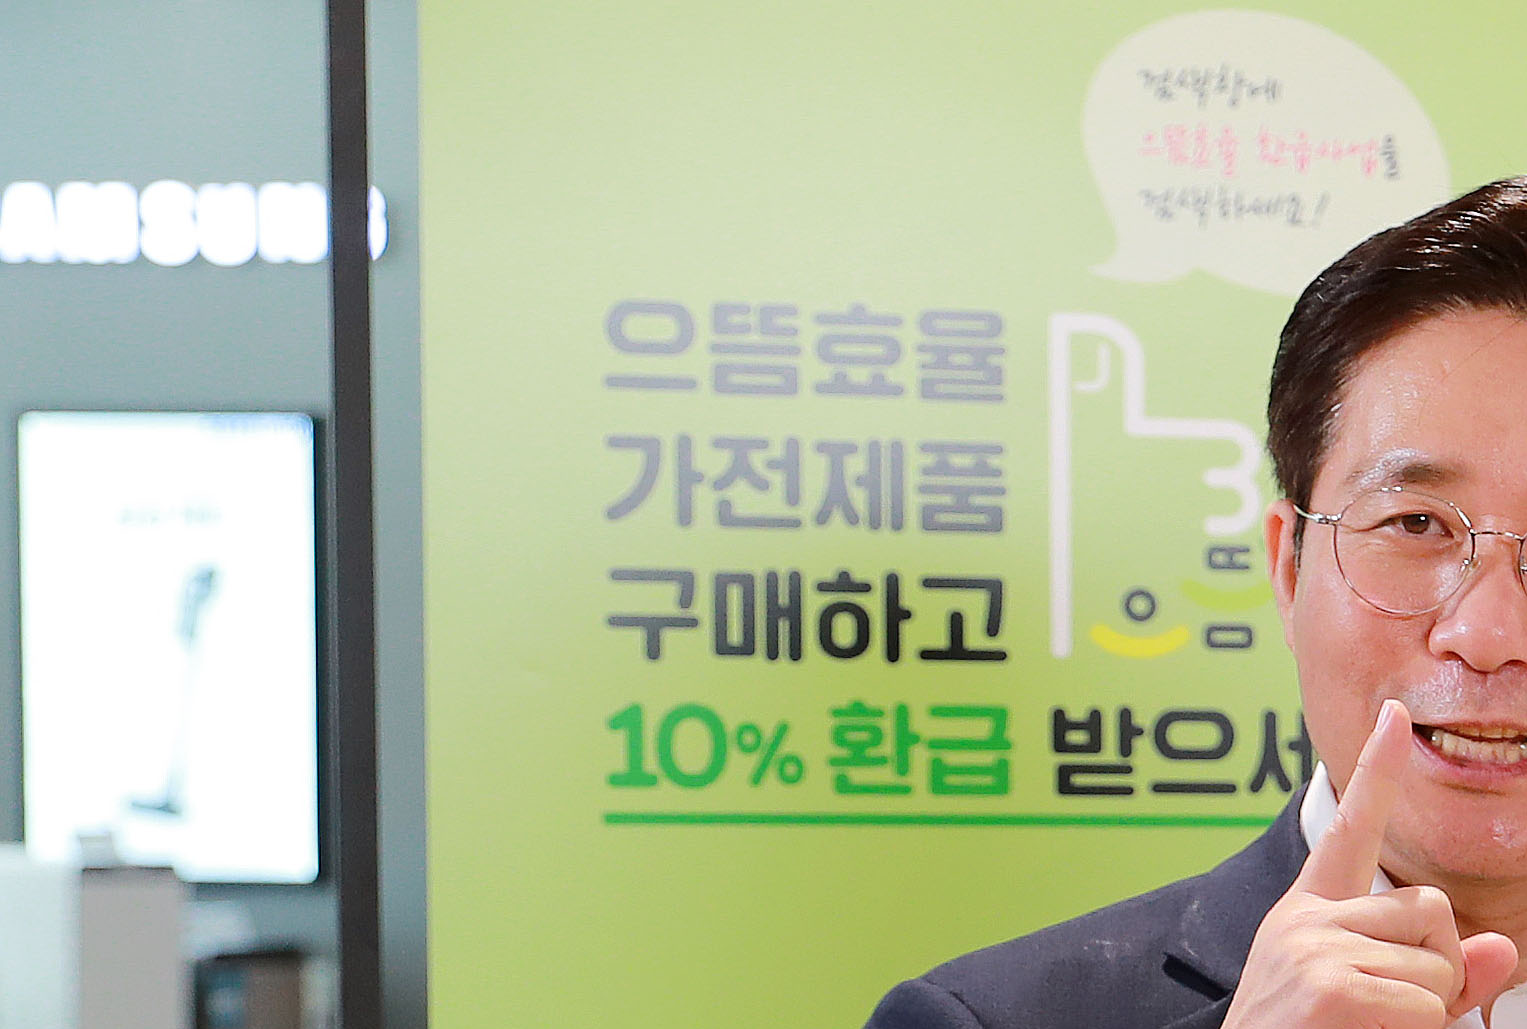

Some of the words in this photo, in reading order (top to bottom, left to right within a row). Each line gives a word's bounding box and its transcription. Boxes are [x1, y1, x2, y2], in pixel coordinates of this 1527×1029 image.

[604, 302, 1006, 402] 으뜸효율
[604, 433, 1007, 534] 가전제품
[607, 568, 1008, 663] 구매하고
[607, 704, 805, 788] 10%
[827, 701, 1012, 796] 환급
